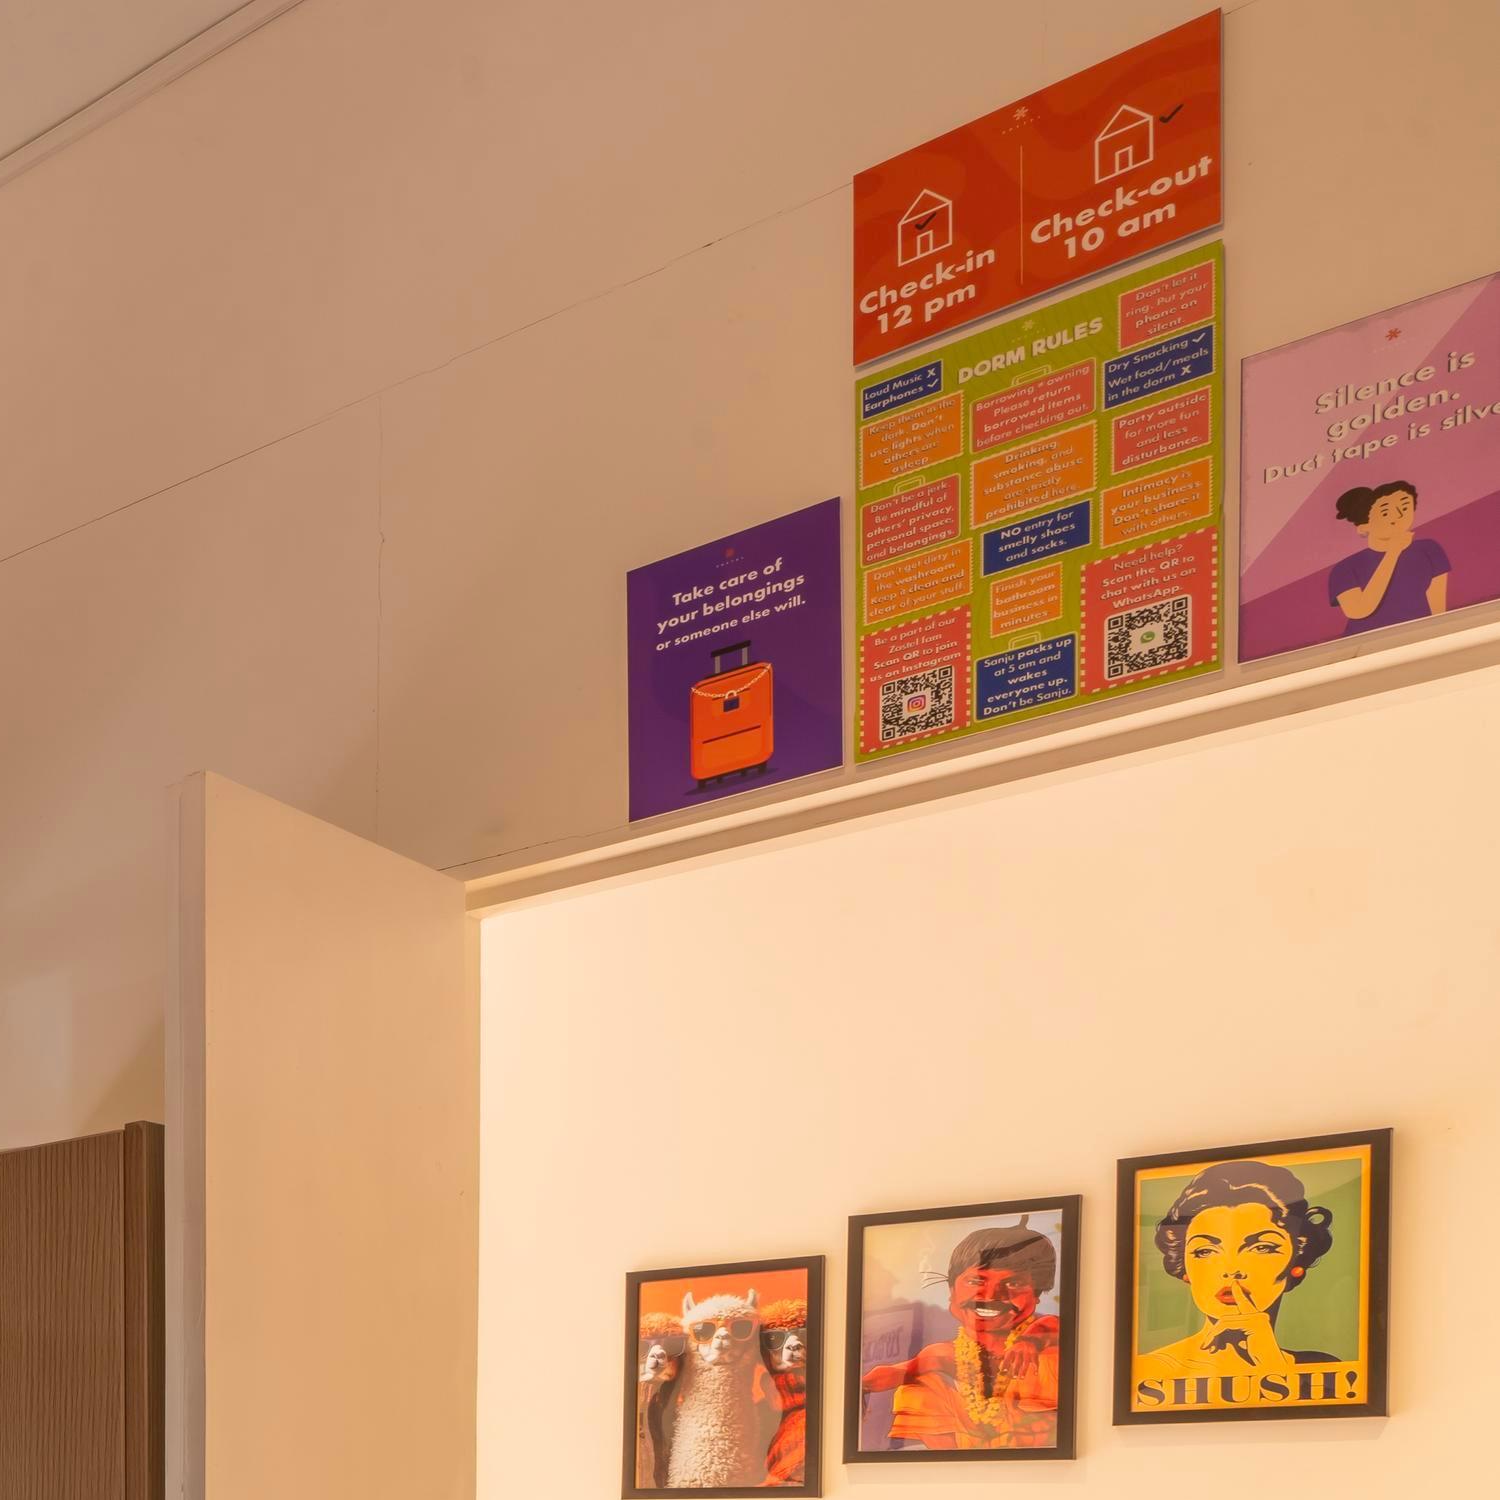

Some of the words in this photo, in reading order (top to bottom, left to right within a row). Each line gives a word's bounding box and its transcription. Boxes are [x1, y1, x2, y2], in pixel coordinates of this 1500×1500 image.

[1031, 155, 1212, 244] Check-out
[1064, 228, 1105, 259] 10
[1118, 202, 1176, 237] am
[859, 248, 995, 315] Check-in
[1135, 283, 1169, 301] Don't
[1172, 278, 1187, 288] let
[1157, 293, 1176, 306] Put
[1179, 282, 1208, 299] your
[877, 305, 912, 334] 12
[924, 282, 976, 323] pm
[1135, 307, 1177, 328] phone
[1181, 299, 1197, 310] on
[1148, 316, 1184, 335] silent.
[958, 346, 1026, 384] DORM
[1032, 317, 1103, 357] RULES
[1108, 361, 1130, 373] Dry
[1133, 338, 1188, 364] Snacking
[1108, 373, 1132, 388] Wet
[1135, 348, 1209, 378] food/meals
[865, 385, 889, 400] Loud
[892, 373, 922, 390] Music
[976, 386, 1034, 412] Borrowing
[1047, 365, 1089, 386] owning
[1108, 391, 1119, 401] in
[1122, 384, 1139, 396] the
[1143, 372, 1175, 389] dorm
[1315, 364, 1436, 415] Silence
[1447, 351, 1476, 373] is
[865, 385, 923, 412] Earphones
[984, 405, 1045, 432] borrowed
[1048, 394, 1081, 410] items
[993, 401, 1030, 417] Please
[1033, 385, 1071, 403] return
[1119, 412, 1154, 429] Party
[1158, 394, 1206, 415] outside
[912, 415, 943, 431] Don't
[1125, 429, 1142, 440] for
[1146, 417, 1176, 432] more
[1180, 409, 1200, 421] fun
[1327, 389, 1460, 442] golden.
[892, 435, 921, 450] lights
[926, 424, 954, 438] when
[976, 431, 1012, 448] before
[1016, 413, 1064, 434] checking
[1136, 434, 1160, 448] and
[1164, 426, 1188, 439] less
[1005, 441, 1057, 462] Drinking
[1051, 446, 1073, 459] and
[1264, 453, 1323, 484] Duct
[1331, 433, 1399, 464] tape
[1408, 422, 1431, 440] is
[984, 472, 1042, 496] substance
[1046, 458, 1083, 474] abuse
[1122, 474, 1178, 498] Intimacy
[871, 498, 899, 513] Don't
[901, 493, 915, 503] be
[875, 513, 889, 523] Be
[890, 498, 933, 519] mindful
[936, 494, 947, 503] of
[985, 491, 1049, 520] prohibited
[1111, 497, 1140, 515] your
[1114, 508, 1149, 526] Don't
[1152, 497, 1190, 514] share
[867, 525, 916, 551] personal
[998, 534, 1037, 552] smelly
[1041, 523, 1076, 539] shoes
[1001, 528, 1021, 539] NO
[1024, 518, 1054, 532] entry
[1057, 511, 1074, 522] for
[867, 549, 887, 562] and
[904, 559, 921, 572] get
[923, 551, 948, 565] dirty
[952, 548, 961, 556] in
[1006, 549, 1028, 562] and
[1032, 539, 1067, 554] socks.
[1113, 554, 1146, 571] Need
[1150, 544, 1183, 559] help?
[672, 585, 714, 606] Take
[719, 568, 758, 590] care
[763, 556, 783, 575] of
[871, 591, 896, 605] Keep
[908, 578, 938, 593] clean
[942, 569, 964, 583] and
[1101, 586, 1127, 600] chat
[1131, 577, 1159, 591] with
[1163, 571, 1177, 582] us
[1180, 567, 1196, 576] on
[1103, 573, 1132, 587] Scan
[1136, 566, 1155, 577] the
[1160, 559, 1179, 570] QR
[656, 608, 699, 635] your
[703, 574, 805, 617] belongings
[993, 600, 1045, 618] business
[1047, 595, 1058, 603] in
[996, 584, 1056, 606] bathroom
[656, 640, 671, 651] or
[674, 618, 738, 646] someone
[742, 608, 771, 623] else
[775, 594, 805, 613] will.
[874, 637, 888, 646] Be
[900, 627, 922, 641] part
[925, 622, 936, 631] of
[938, 618, 957, 627] our
[870, 674, 882, 682] us
[885, 669, 900, 678] on
[902, 652, 961, 673] Instagram
[874, 658, 900, 669] Scan
[903, 651, 919, 661] QR
[922, 647, 933, 655] to
[935, 641, 958, 654] join
[984, 653, 1015, 668] Sanju
[1018, 642, 1053, 660] packs
[1056, 638, 1072, 648] up
[994, 667, 1005, 677] at
[1008, 664, 1016, 673] 5
[1018, 658, 1036, 669] am
[1039, 651, 1062, 664] and
[987, 682, 1045, 703] everyone
[1048, 677, 1068, 688] up.
[1008, 669, 1048, 685] wakes
[983, 700, 1017, 716] Don't
[1020, 696, 1033, 706] be
[1037, 687, 1072, 701] Sanju.
[1137, 1370, 1357, 1406] SHUSH!
